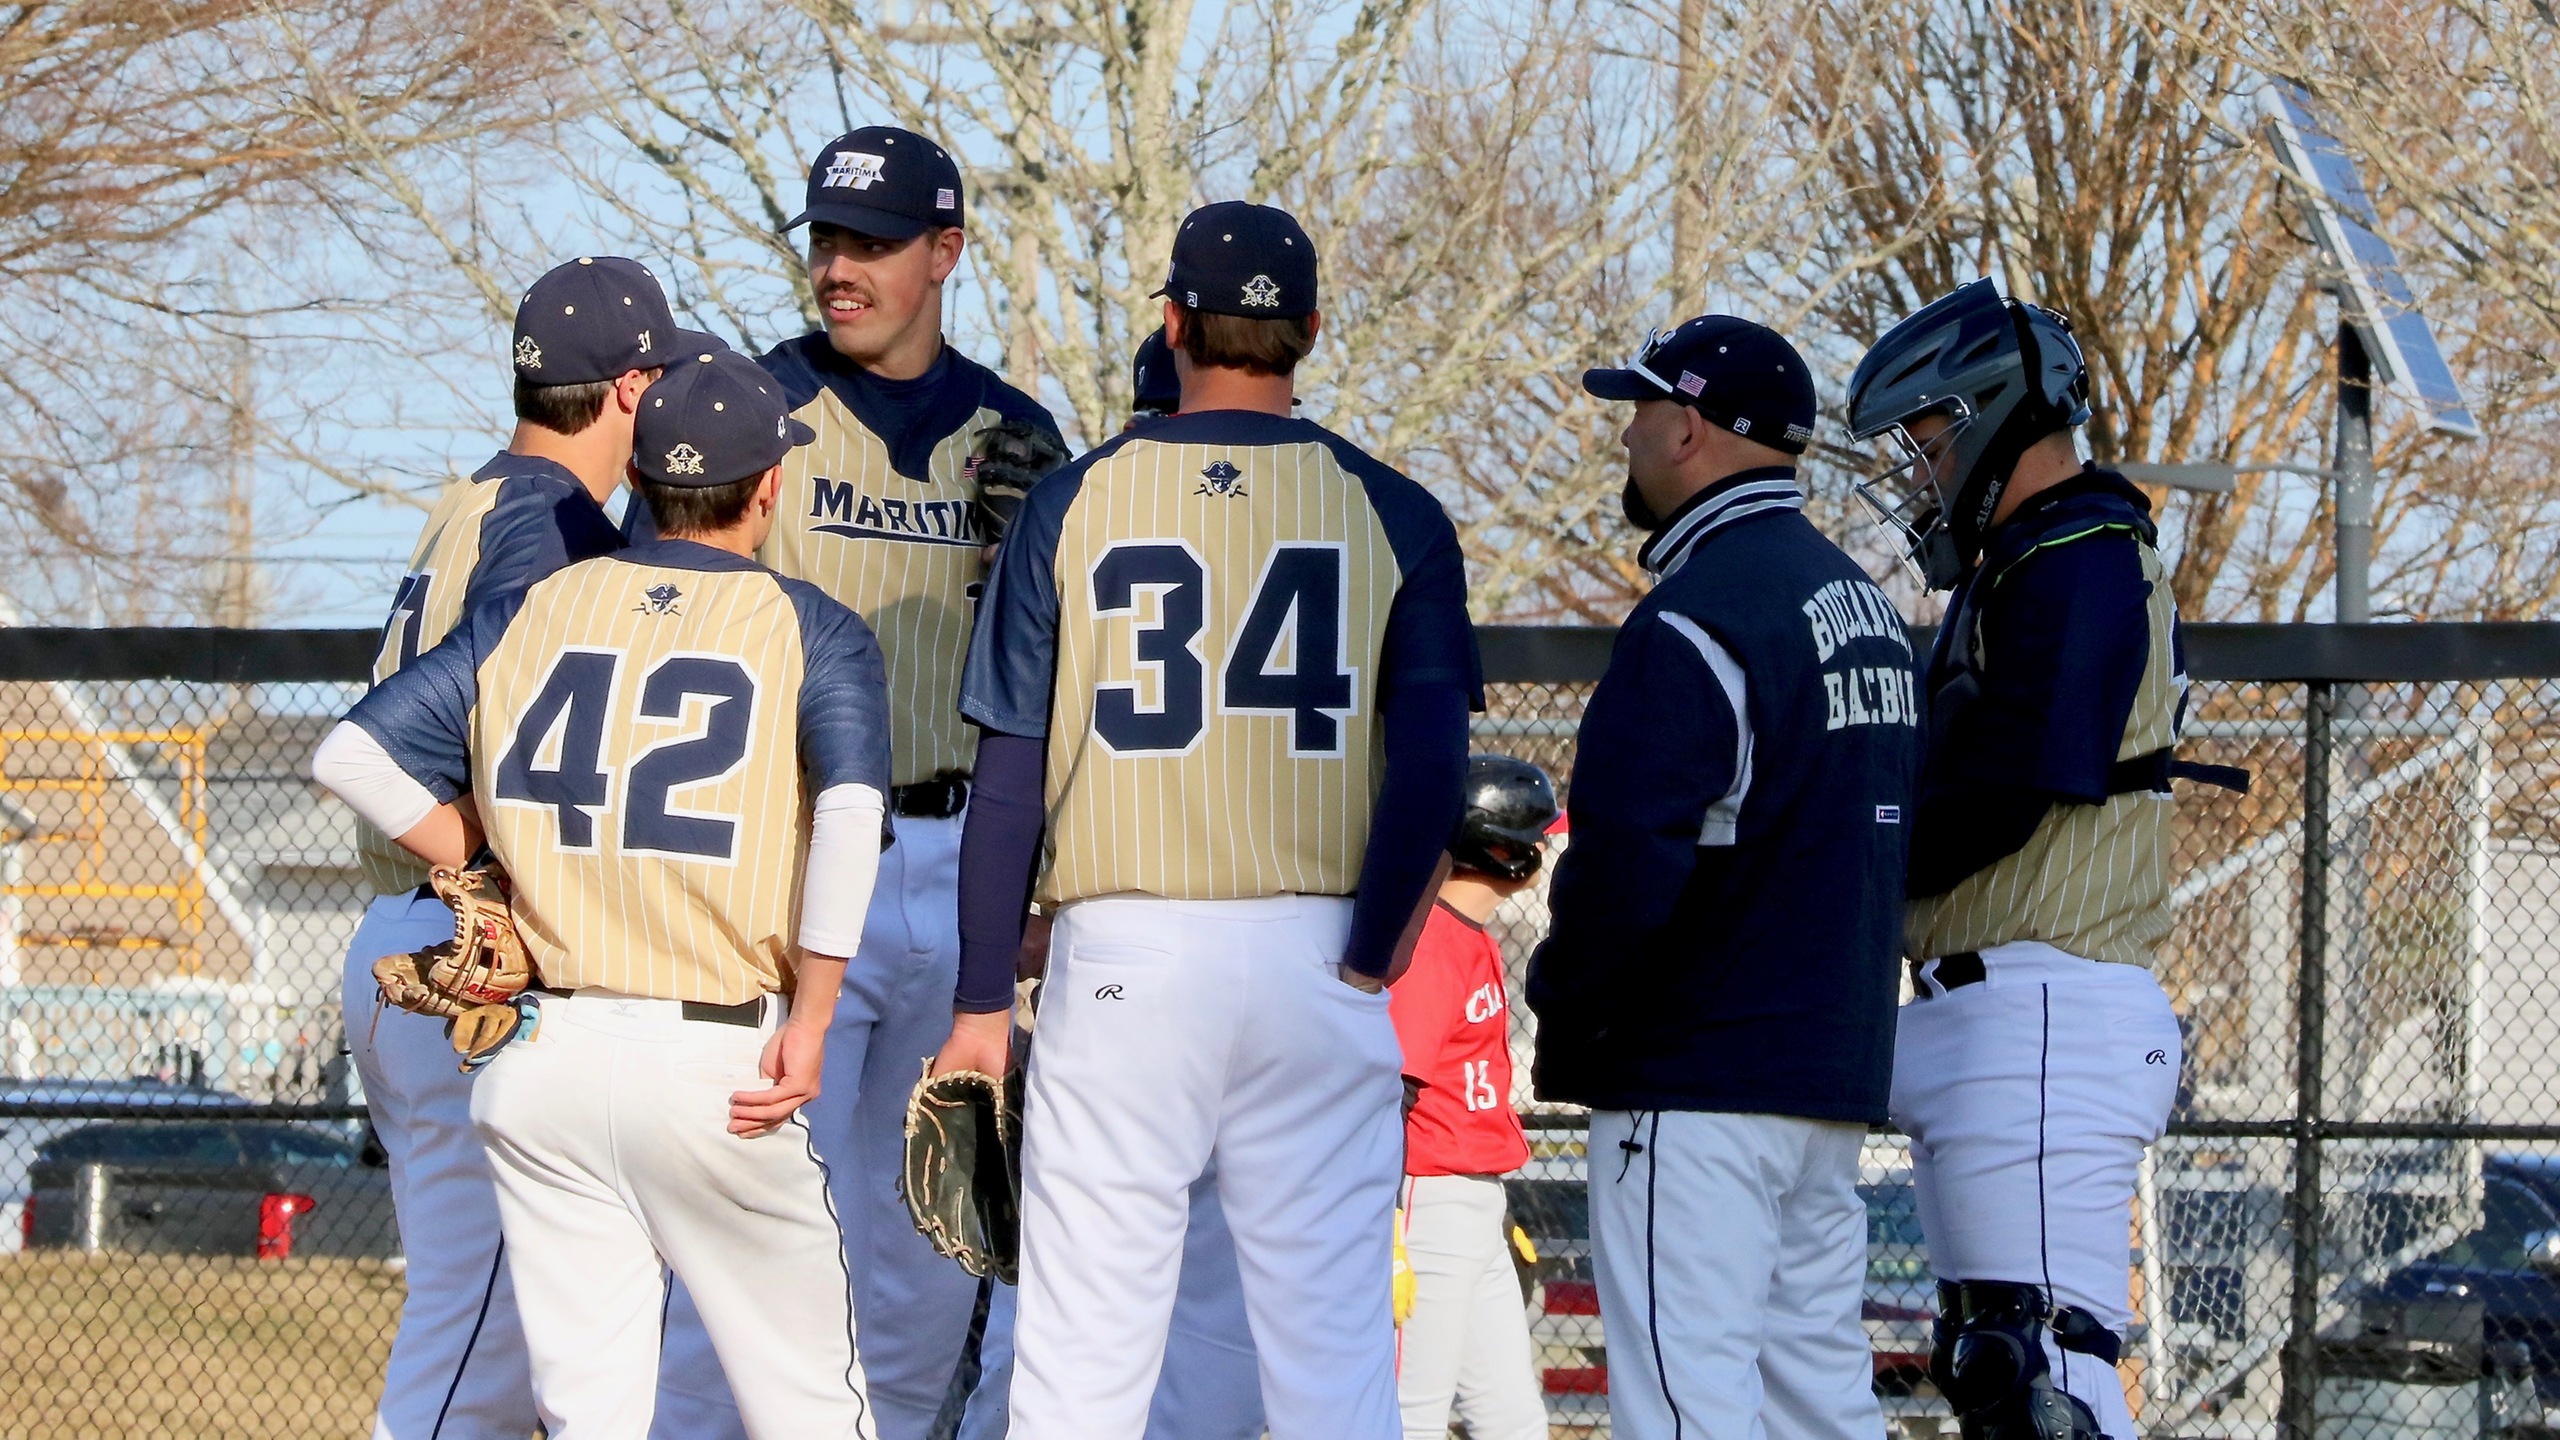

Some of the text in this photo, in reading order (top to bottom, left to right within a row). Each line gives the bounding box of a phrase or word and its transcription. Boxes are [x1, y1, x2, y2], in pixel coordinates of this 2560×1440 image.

[831, 167, 877, 178] MARITIME
[637, 330, 651, 353] 31
[809, 476, 990, 543] MARITIM
[1086, 537, 1359, 760] 34
[490, 644, 763, 868] 42
[1464, 1060, 1498, 1112] 15
